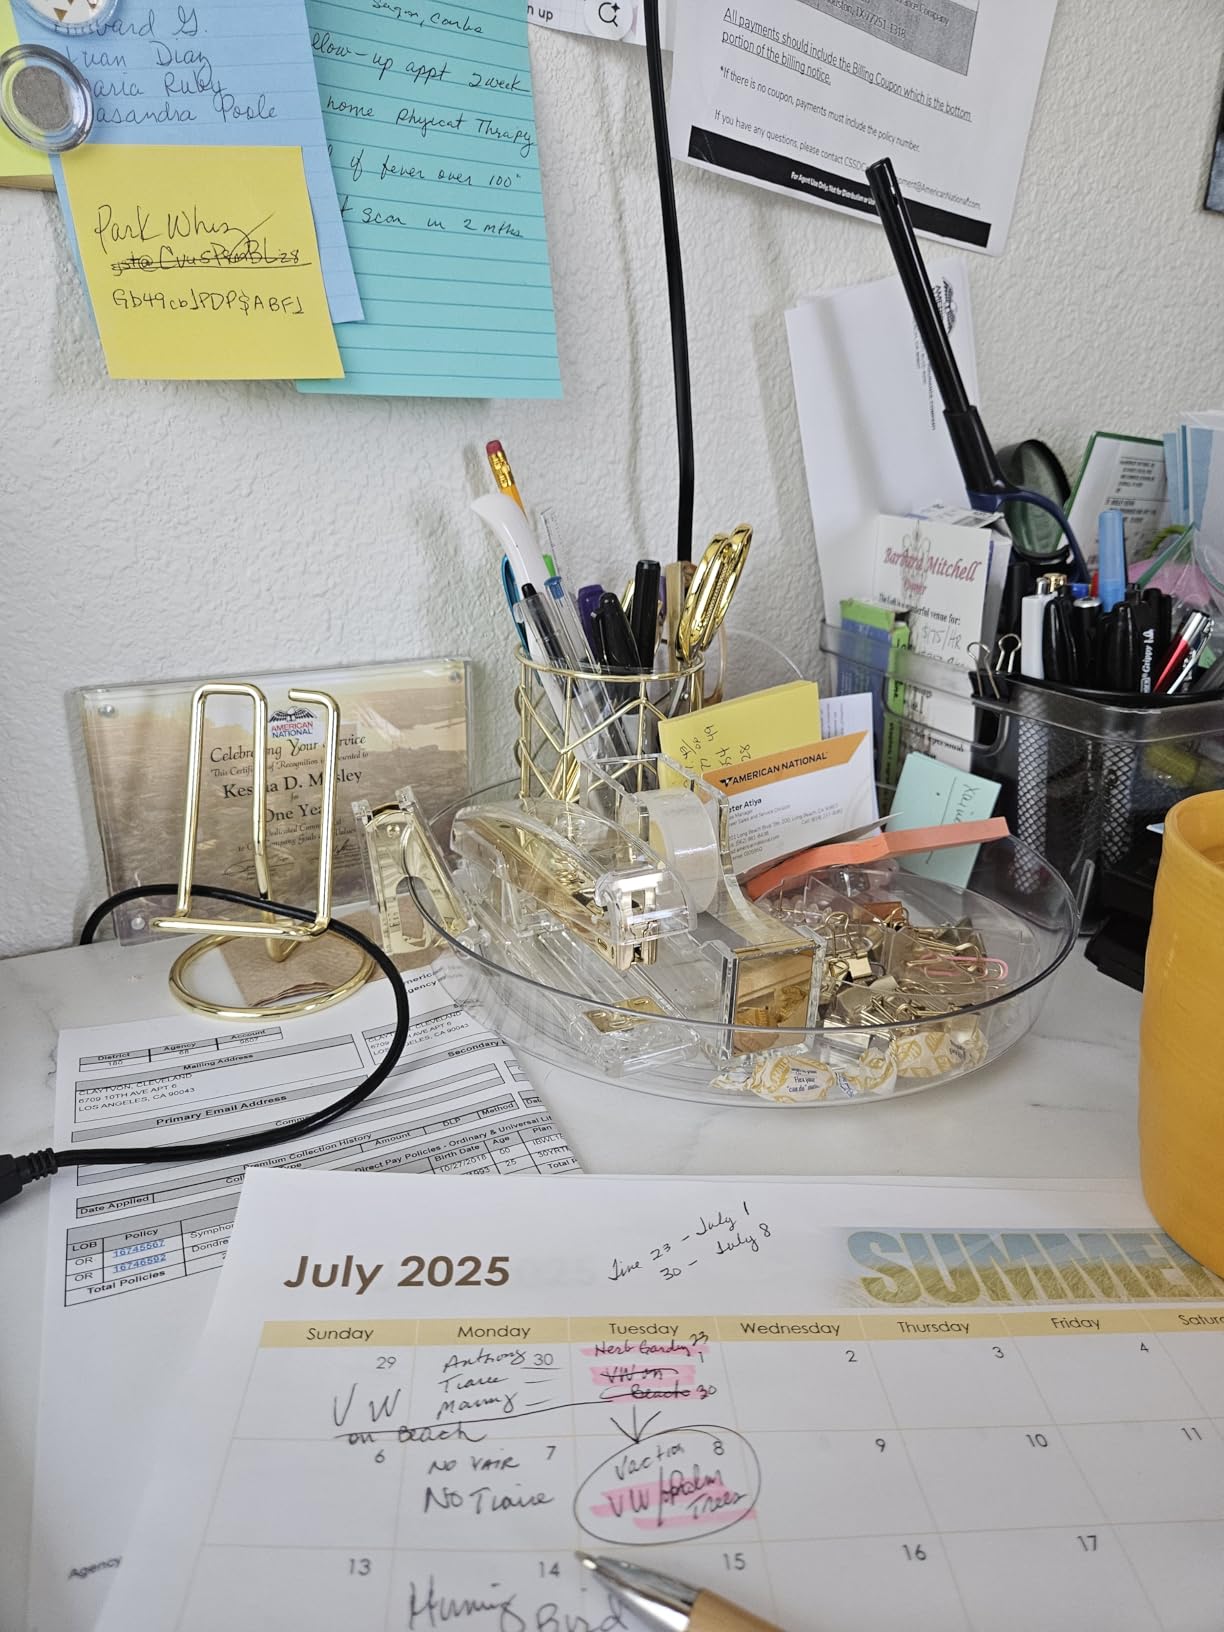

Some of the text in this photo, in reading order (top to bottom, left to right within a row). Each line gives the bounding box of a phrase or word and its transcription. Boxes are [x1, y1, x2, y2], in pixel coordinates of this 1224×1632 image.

[538, 8, 553, 21] up
[721, 31, 832, 86] portion of the billing notice.
[724, 7, 738, 24] All
[738, 14, 780, 42] payments
[782, 31, 809, 53] should
[810, 43, 838, 66] include
[838, 57, 851, 72] the
[853, 61, 875, 84] Billing
[875, 72, 903, 95] Coupon
[903, 85, 925, 105] which
[933, 97, 945, 112] the
[945, 101, 972, 122] bottom
[406, 61, 452, 85] appt
[84, 78, 145, 98] aria
[730, 70, 749, 88] there
[757, 83, 767, 95] no
[767, 86, 795, 106] coupon,
[796, 97, 827, 119] payments
[96, 102, 198, 124] asandra
[722, 114, 734, 127] you
[735, 117, 752, 133] have
[94, 204, 163, 255] Park
[926, 556, 983, 583] Mitchell
[270, 721, 314, 732] AMERICAN
[271, 728, 313, 739] NATIONAL
[286, 738, 319, 757] Your
[283, 769, 364, 791] D. Msley
[732, 752, 828, 786] AMERICAN NATIONAL
[265, 804, 323, 823] One Yea
[743, 797, 762, 809] Atiya
[97, 1029, 267, 1062] District Agency Account
[447, 1039, 500, 1058] Secondary
[183, 1054, 254, 1071] Mailing Address
[105, 1084, 169, 1101] 10TH AVE APT
[136, 1073, 193, 1088] CLEVELAND
[78, 1086, 196, 1112] LOS ANGELES, CA 90043
[156, 1094, 288, 1127] Primary Email Address
[288, 1142, 338, 1160] Collection
[338, 1133, 373, 1147] History
[385, 1156, 402, 1168] Pay
[404, 1144, 443, 1160] Policies
[448, 1130, 488, 1147] Ordinary
[498, 1117, 541, 1133] Universal
[80, 1102, 515, 1215] Date Applied Amount DLP Method
[72, 1124, 553, 1253] LOB Policy Birth Date Age Plan
[87, 1282, 116, 1295] Total
[120, 1270, 166, 1287] Policies
[547, 1159, 570, 1169] Total
[650, 1200, 750, 1261] 23 July 1
[74, 1256, 94, 1266] OR
[660, 1222, 771, 1281] 30 July 8
[74, 1272, 94, 1282] OR
[283, 1255, 510, 1296] July 2025
[306, 1316, 1101, 1342] Sunday Monday Tuesday Wednesday Thursday Friday
[376, 1356, 397, 1370] 29
[533, 1353, 554, 1367] 30
[845, 1349, 858, 1364] 2
[991, 1345, 1005, 1360] 3
[1139, 1342, 1150, 1354] 4
[374, 1426, 1203, 1464] 6 7 8 9 10 11
[348, 1534, 1099, 1578] 13 14 15 16 17
